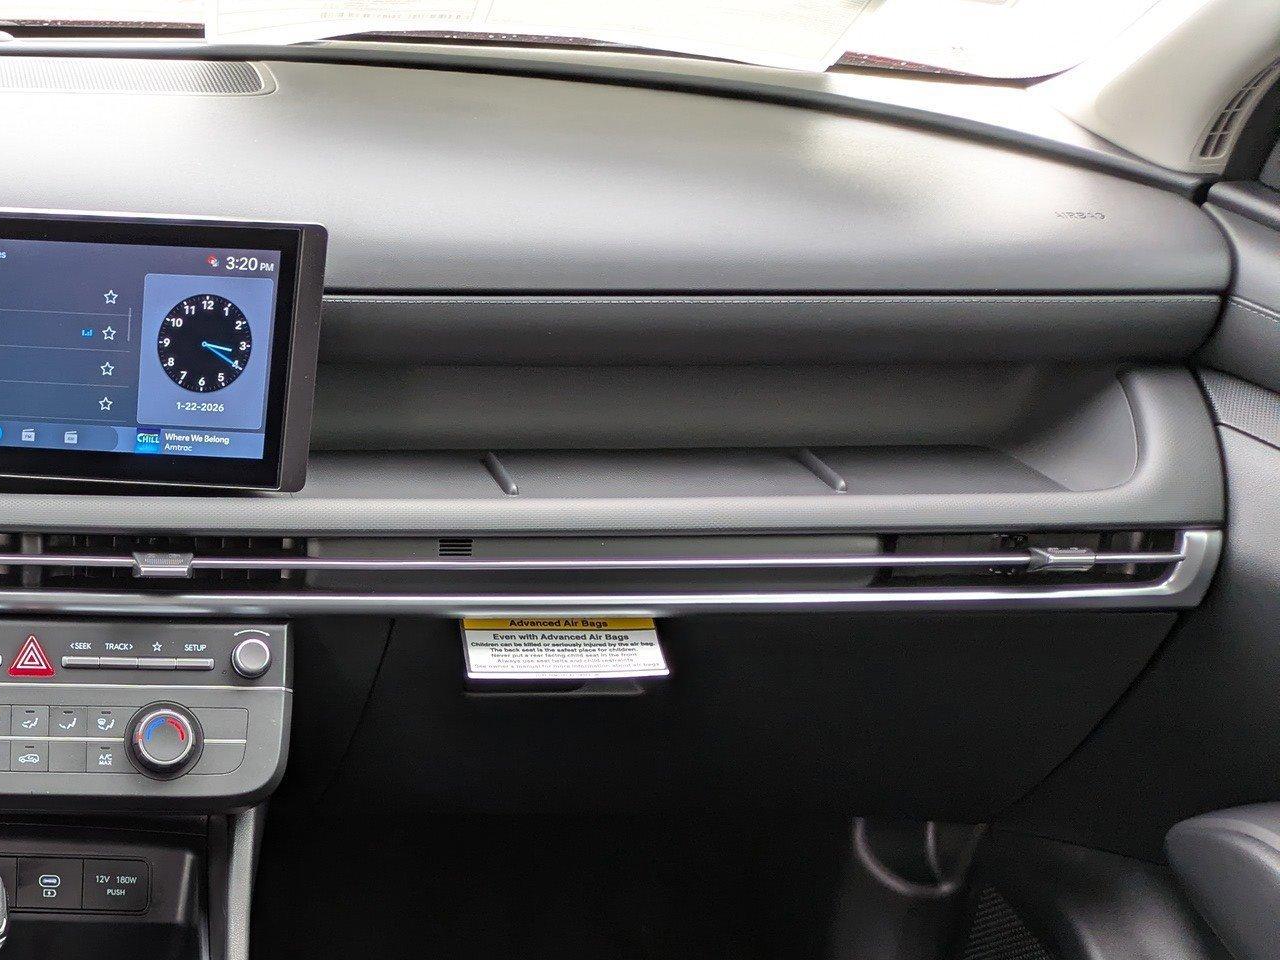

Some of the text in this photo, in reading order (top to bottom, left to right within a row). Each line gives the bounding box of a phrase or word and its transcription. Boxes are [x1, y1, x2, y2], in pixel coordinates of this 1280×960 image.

[225, 256, 275, 272] 3:20 PM
[184, 305, 195, 315] 11
[202, 300, 214, 310] 12
[171, 317, 183, 328] 10
[235, 320, 242, 330] 2
[163, 338, 171, 347] 9
[239, 341, 247, 350] 3
[168, 357, 175, 366] 8
[180, 371, 187, 379] 7
[218, 373, 224, 382] 5
[198, 377, 206, 386] 6
[176, 401, 225, 413] 1-22-2026
[164, 432, 230, 445] Where We Belong
[509, 618, 608, 629] Advanced Air Bags
[493, 632, 629, 642] Even with Advanced Air Bags
[184, 643, 207, 652] SETUP
[98, 753, 113, 761] A/C
[95, 874, 138, 885] 12V 180W
[106, 888, 126, 897] PUSH
